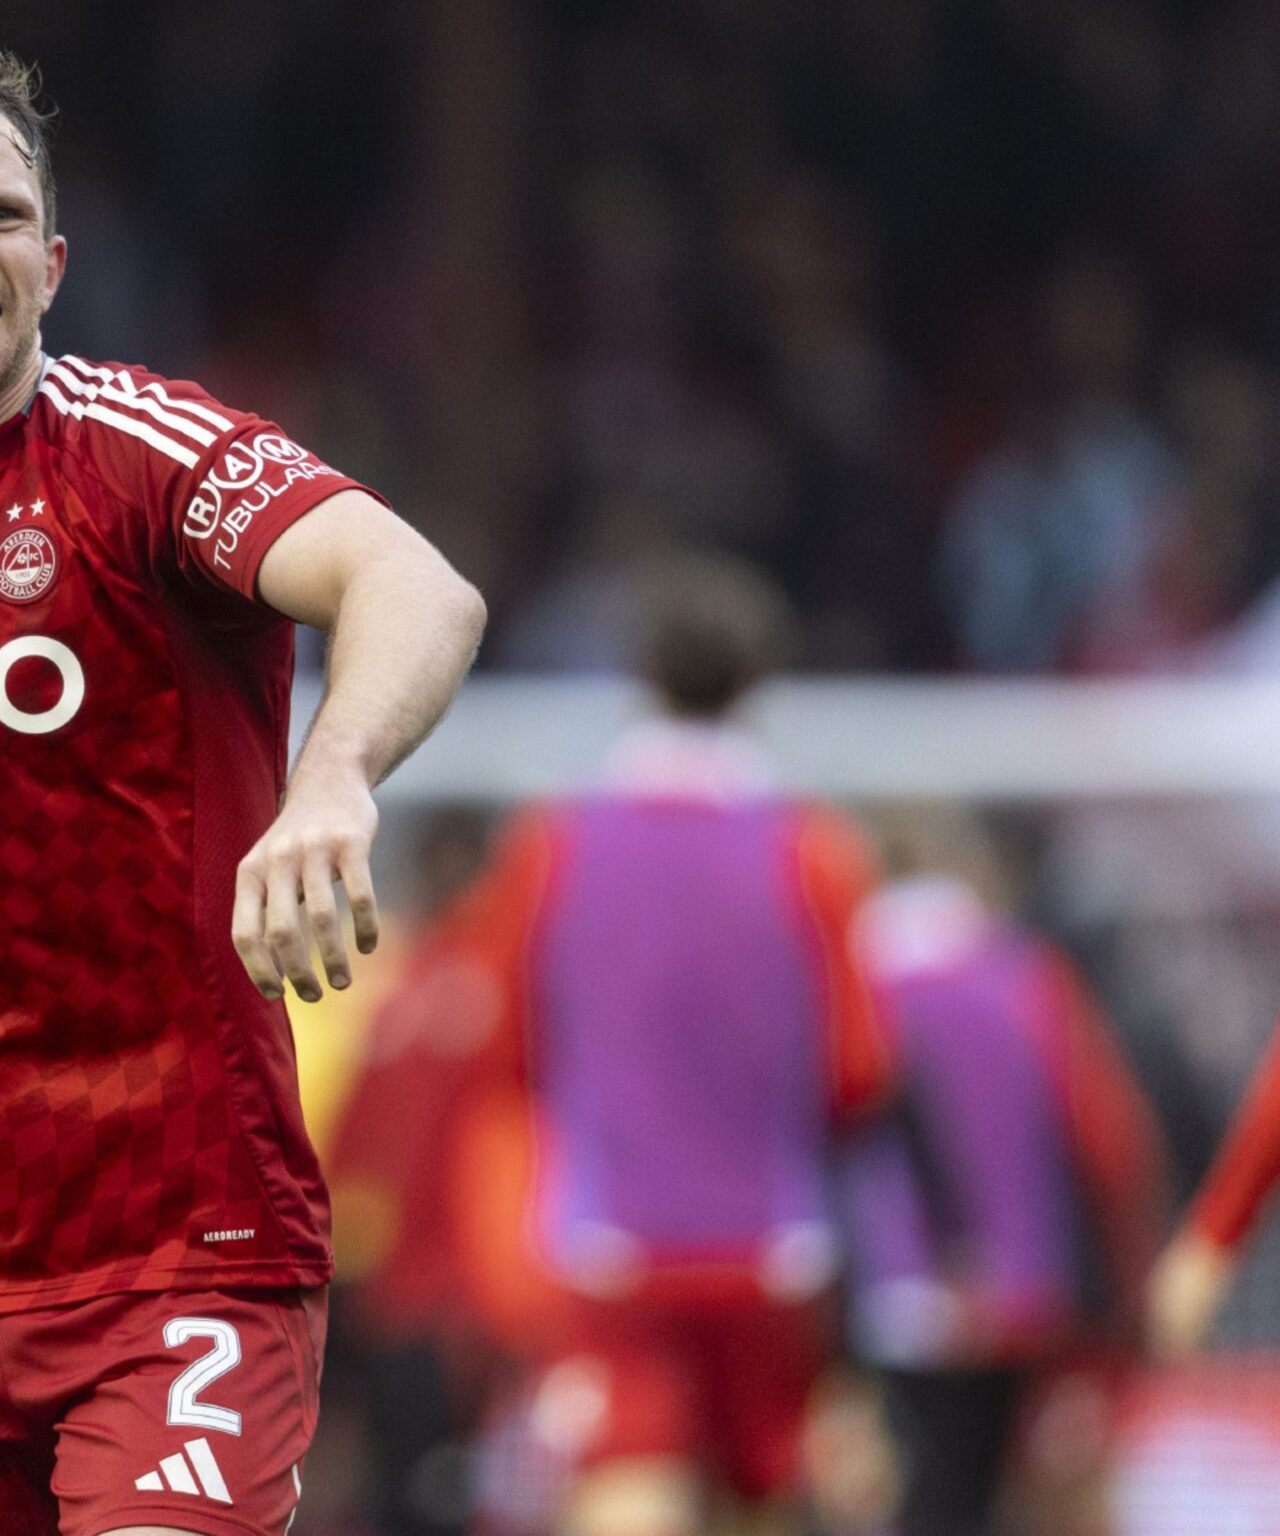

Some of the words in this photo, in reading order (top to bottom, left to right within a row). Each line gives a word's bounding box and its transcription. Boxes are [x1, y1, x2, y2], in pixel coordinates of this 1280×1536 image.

[35, 563, 52, 588] CLUB
[203, 1228, 256, 1243] AEROREADY
[163, 1316, 242, 1437] 2
